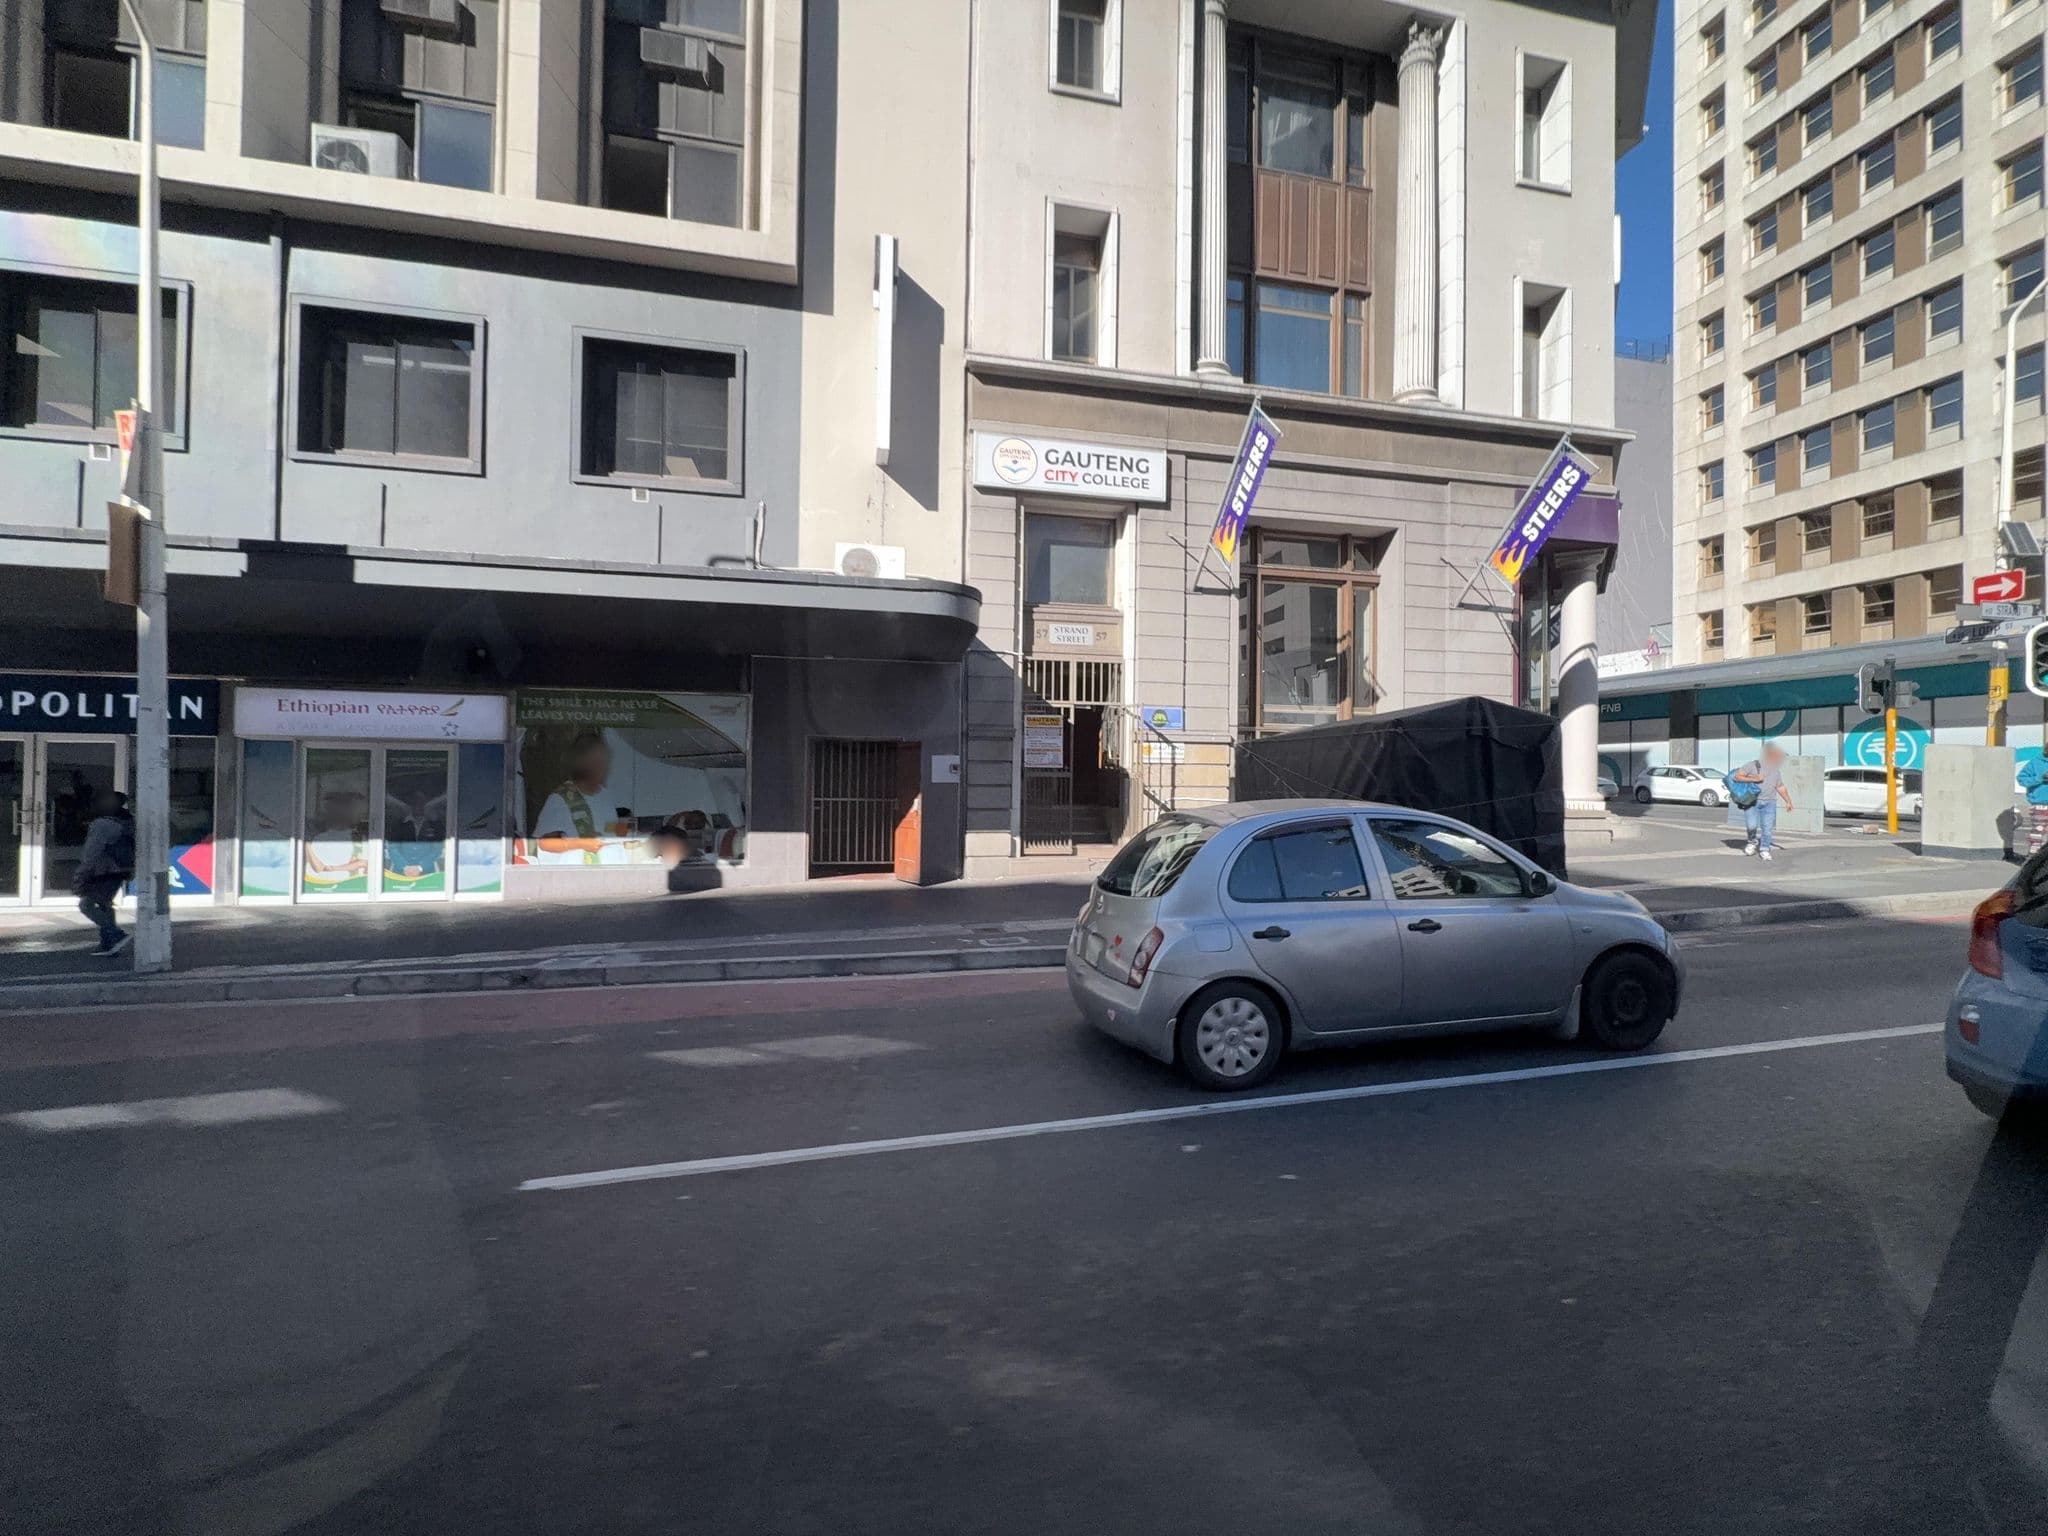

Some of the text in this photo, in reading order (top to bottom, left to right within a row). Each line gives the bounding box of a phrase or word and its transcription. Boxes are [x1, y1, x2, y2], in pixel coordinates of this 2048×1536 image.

[1044, 449, 1150, 474] GAUTENG
[1231, 430, 1269, 516] STEERS
[1044, 470, 1150, 490] CITY COLLEGE
[1521, 465, 1581, 543] STEERS
[1996, 604, 2022, 617] STRAND
[1036, 628, 1048, 639] 57
[1054, 625, 1089, 635] STRAND
[1096, 631, 1108, 641] 57
[1056, 634, 1087, 644] STREET
[0, 690, 203, 720] POLITN
[277, 698, 370, 716] Ethiopian
[521, 697, 659, 710] THE SMILE THAT NEVER
[1600, 702, 1622, 713] FNB
[521, 710, 637, 722] LEAVES YOU ALONE
